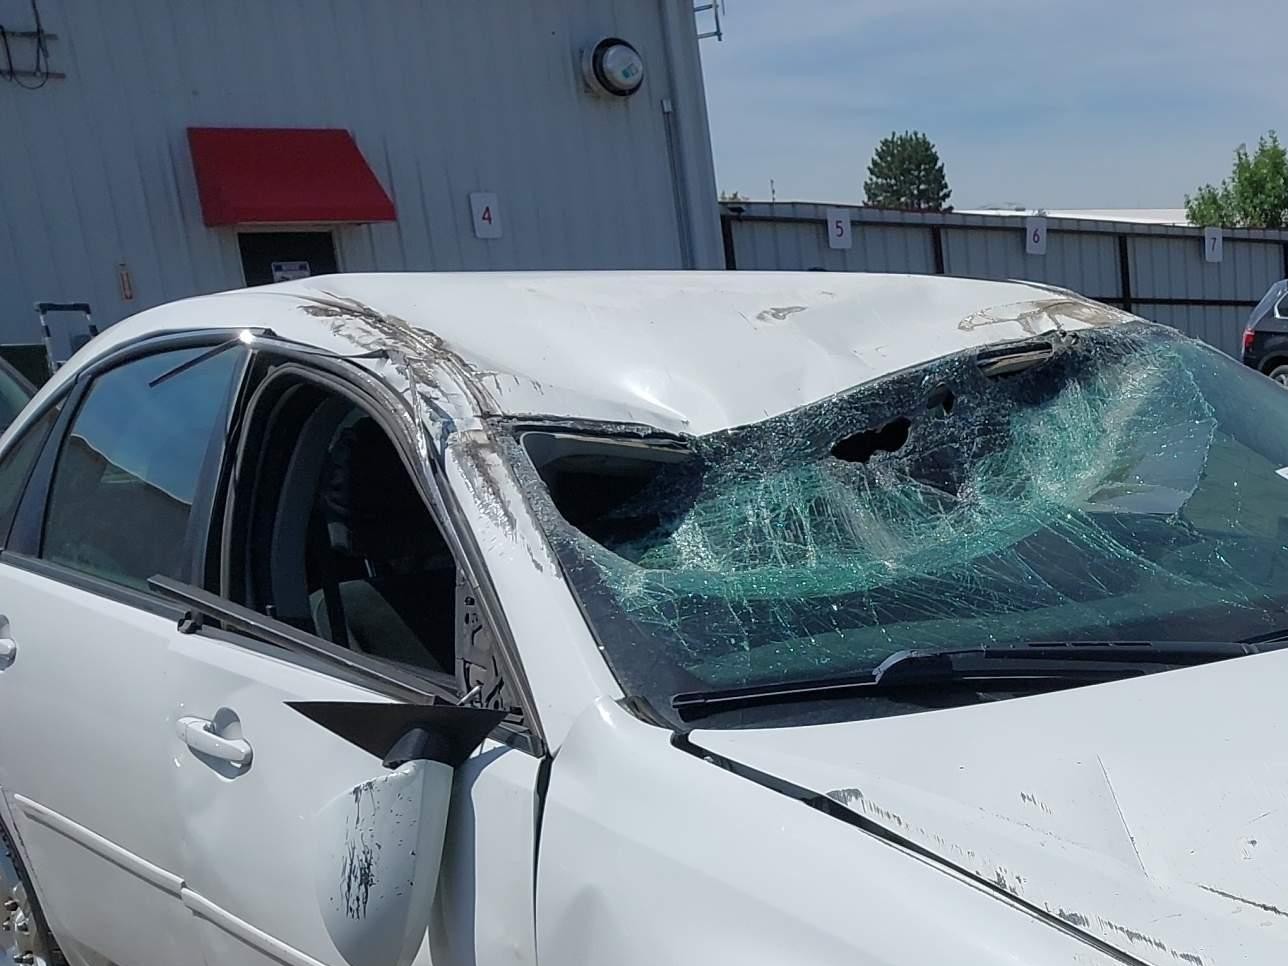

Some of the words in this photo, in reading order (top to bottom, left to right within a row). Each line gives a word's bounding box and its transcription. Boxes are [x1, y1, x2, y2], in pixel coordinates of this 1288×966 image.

[482, 205, 492, 225] 4
[835, 220, 844, 238] 5
[1032, 228, 1040, 244] 6
[1210, 237, 1217, 252] 7
